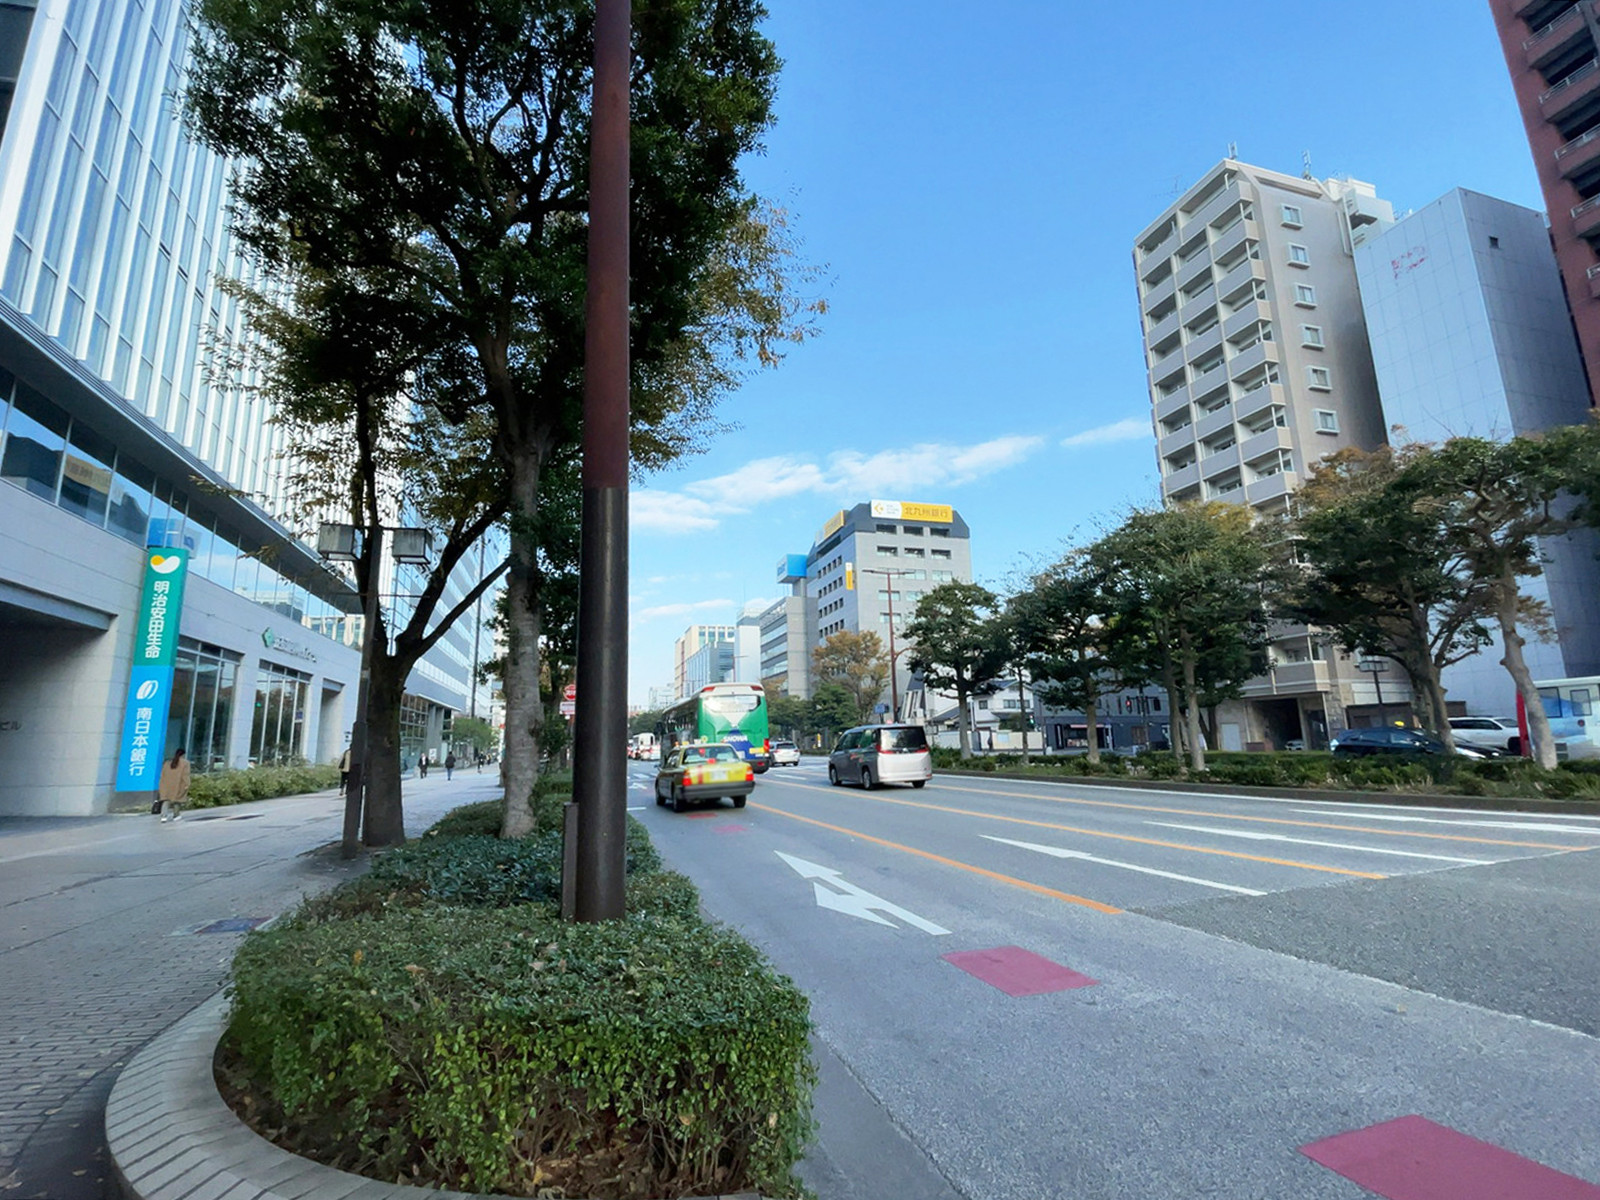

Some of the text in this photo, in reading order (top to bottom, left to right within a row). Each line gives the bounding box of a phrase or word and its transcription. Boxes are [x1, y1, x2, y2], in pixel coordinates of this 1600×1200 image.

[145, 580, 170, 659] 明治安田生命
[129, 707, 152, 776] 南日本銀行
